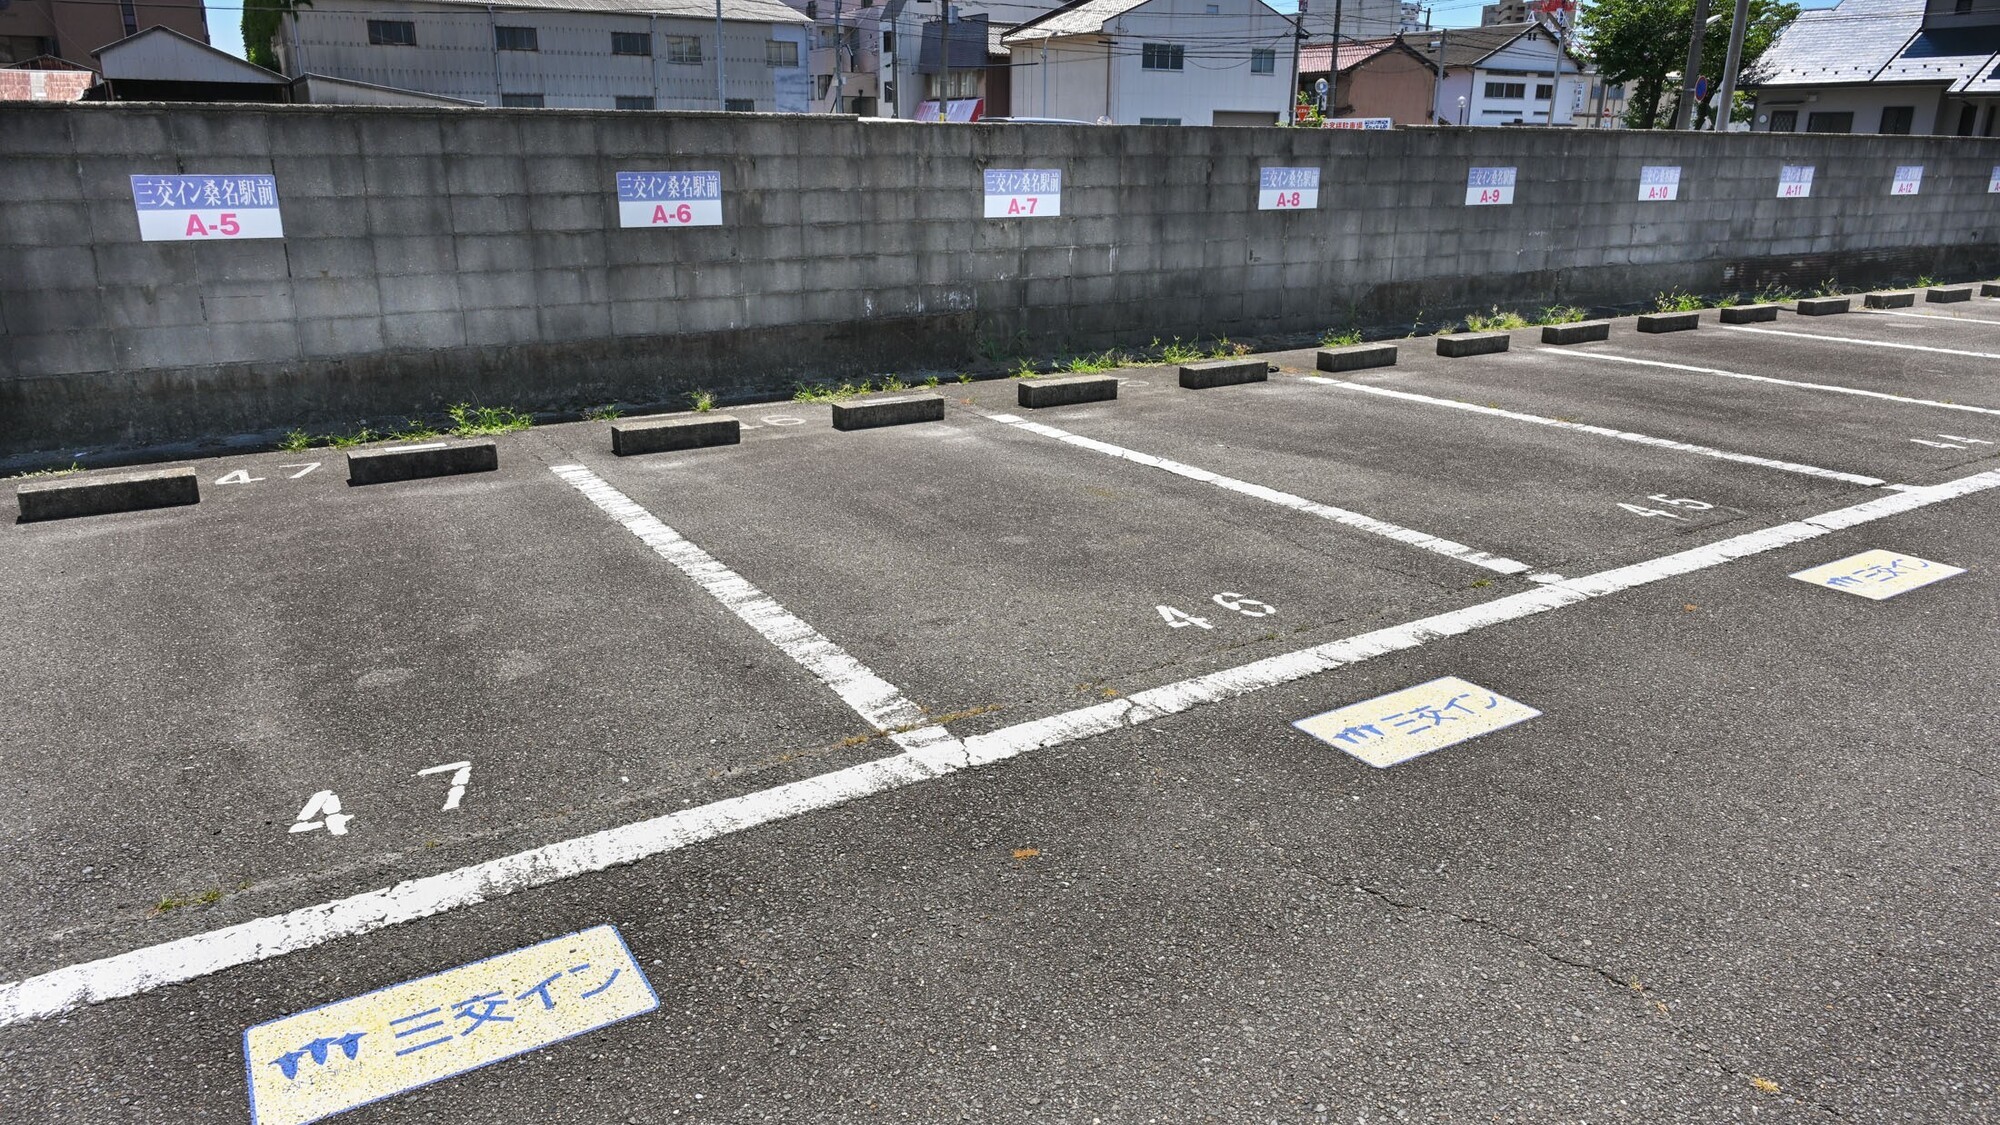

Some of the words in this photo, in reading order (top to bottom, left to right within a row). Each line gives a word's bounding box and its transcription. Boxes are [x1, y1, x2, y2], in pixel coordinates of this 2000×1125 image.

[136, 179, 273, 207] 三交イン桑名駅前
[620, 175, 718, 199] 三交イン桑名駅前
[986, 172, 1059, 193] 三交イン桑名駅前
[1649, 186, 1669, 199] A-10
[1785, 184, 1802, 196] A-11
[1897, 182, 1914, 194] A-12
[1008, 197, 1038, 215] A-7
[1276, 192, 1301, 207] A-8
[1480, 189, 1500, 203] A-9
[186, 213, 241, 236] A-5
[652, 203, 692, 224] A-6
[214, 462, 322, 486] 47
[1616, 494, 1714, 521] 45
[1852, 558, 1929, 582] 三交イン
[1155, 592, 1277, 630] 46
[1380, 693, 1498, 735] 三交イン
[287, 760, 473, 836] 47
[389, 963, 621, 1057] 三交イン
